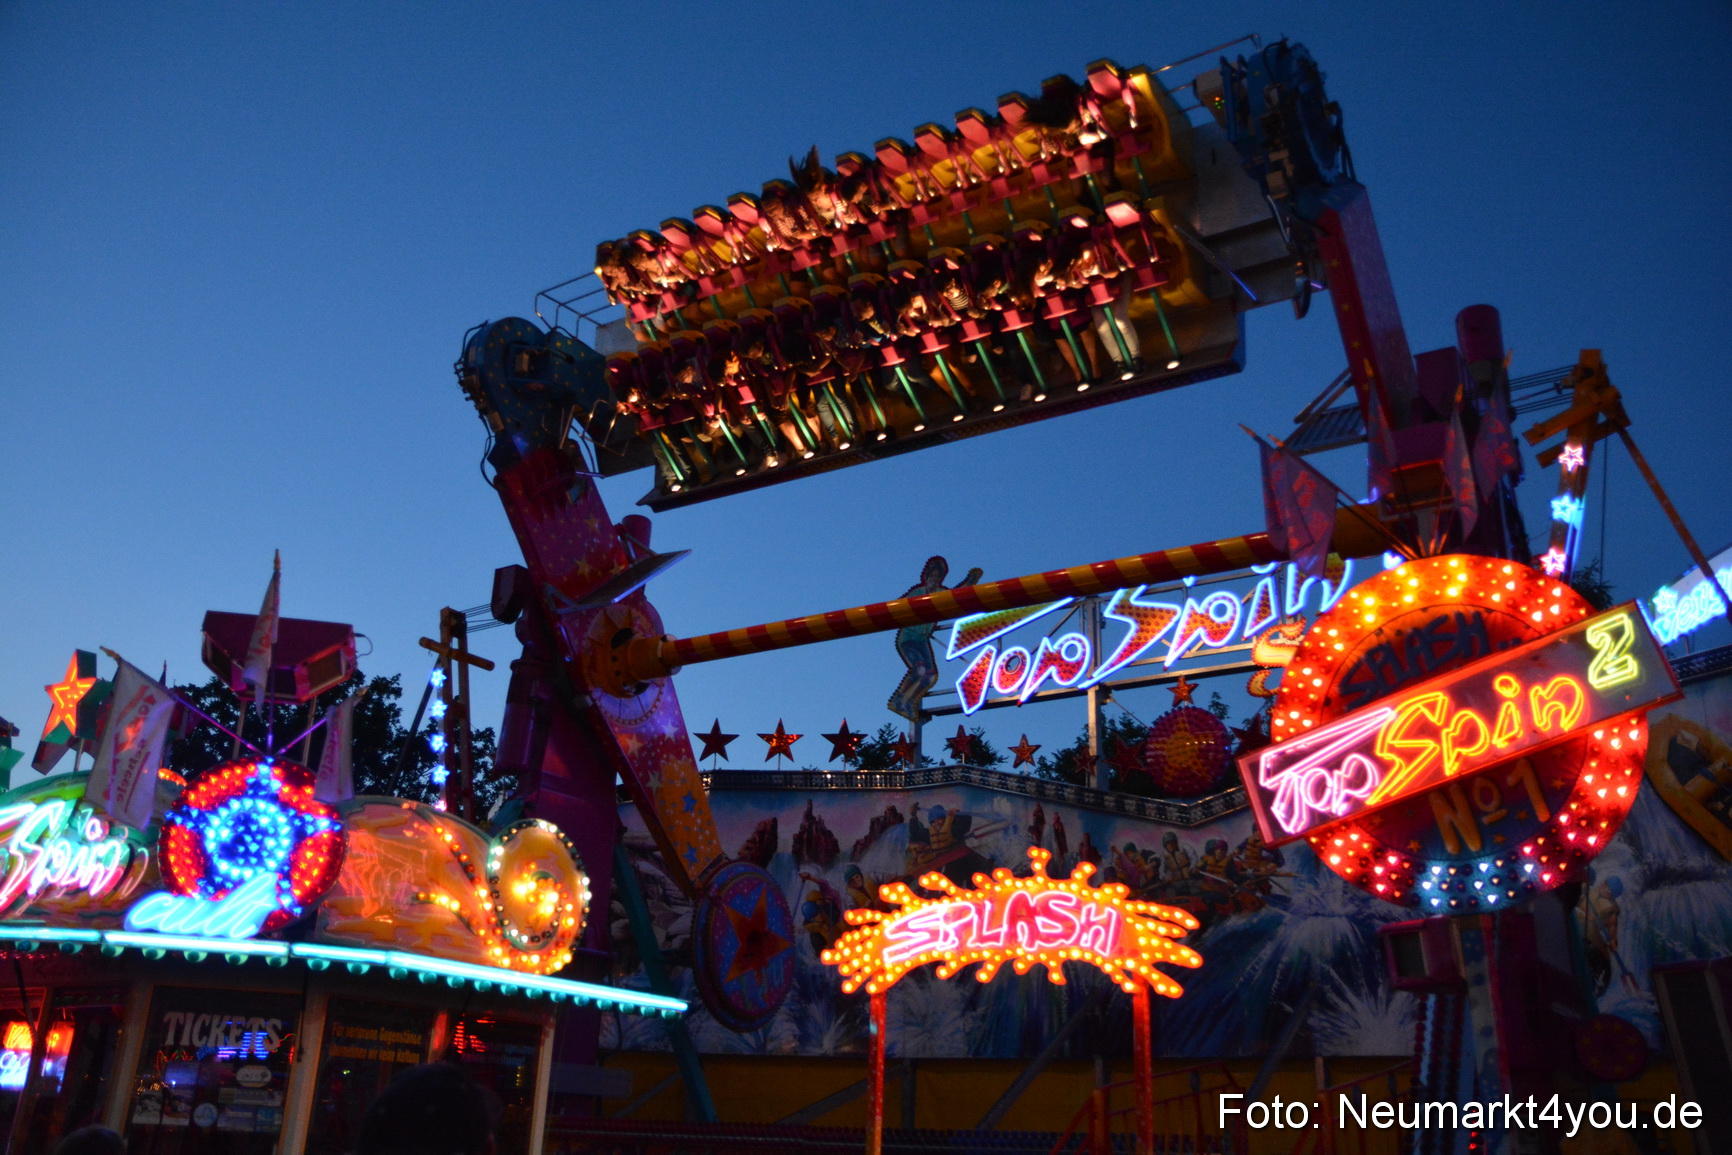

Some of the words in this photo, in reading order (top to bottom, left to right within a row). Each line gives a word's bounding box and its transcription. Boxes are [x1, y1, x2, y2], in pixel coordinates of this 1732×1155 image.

[946, 596, 1094, 716] Top
[1257, 706, 1396, 835] Top
[1366, 673, 1588, 806] Spin
[1585, 612, 1641, 691] 2
[1506, 757, 1552, 824] 1
[128, 875, 279, 938] cult
[882, 891, 1121, 964] SPLASH
[163, 1012, 282, 1052] TICKETS
